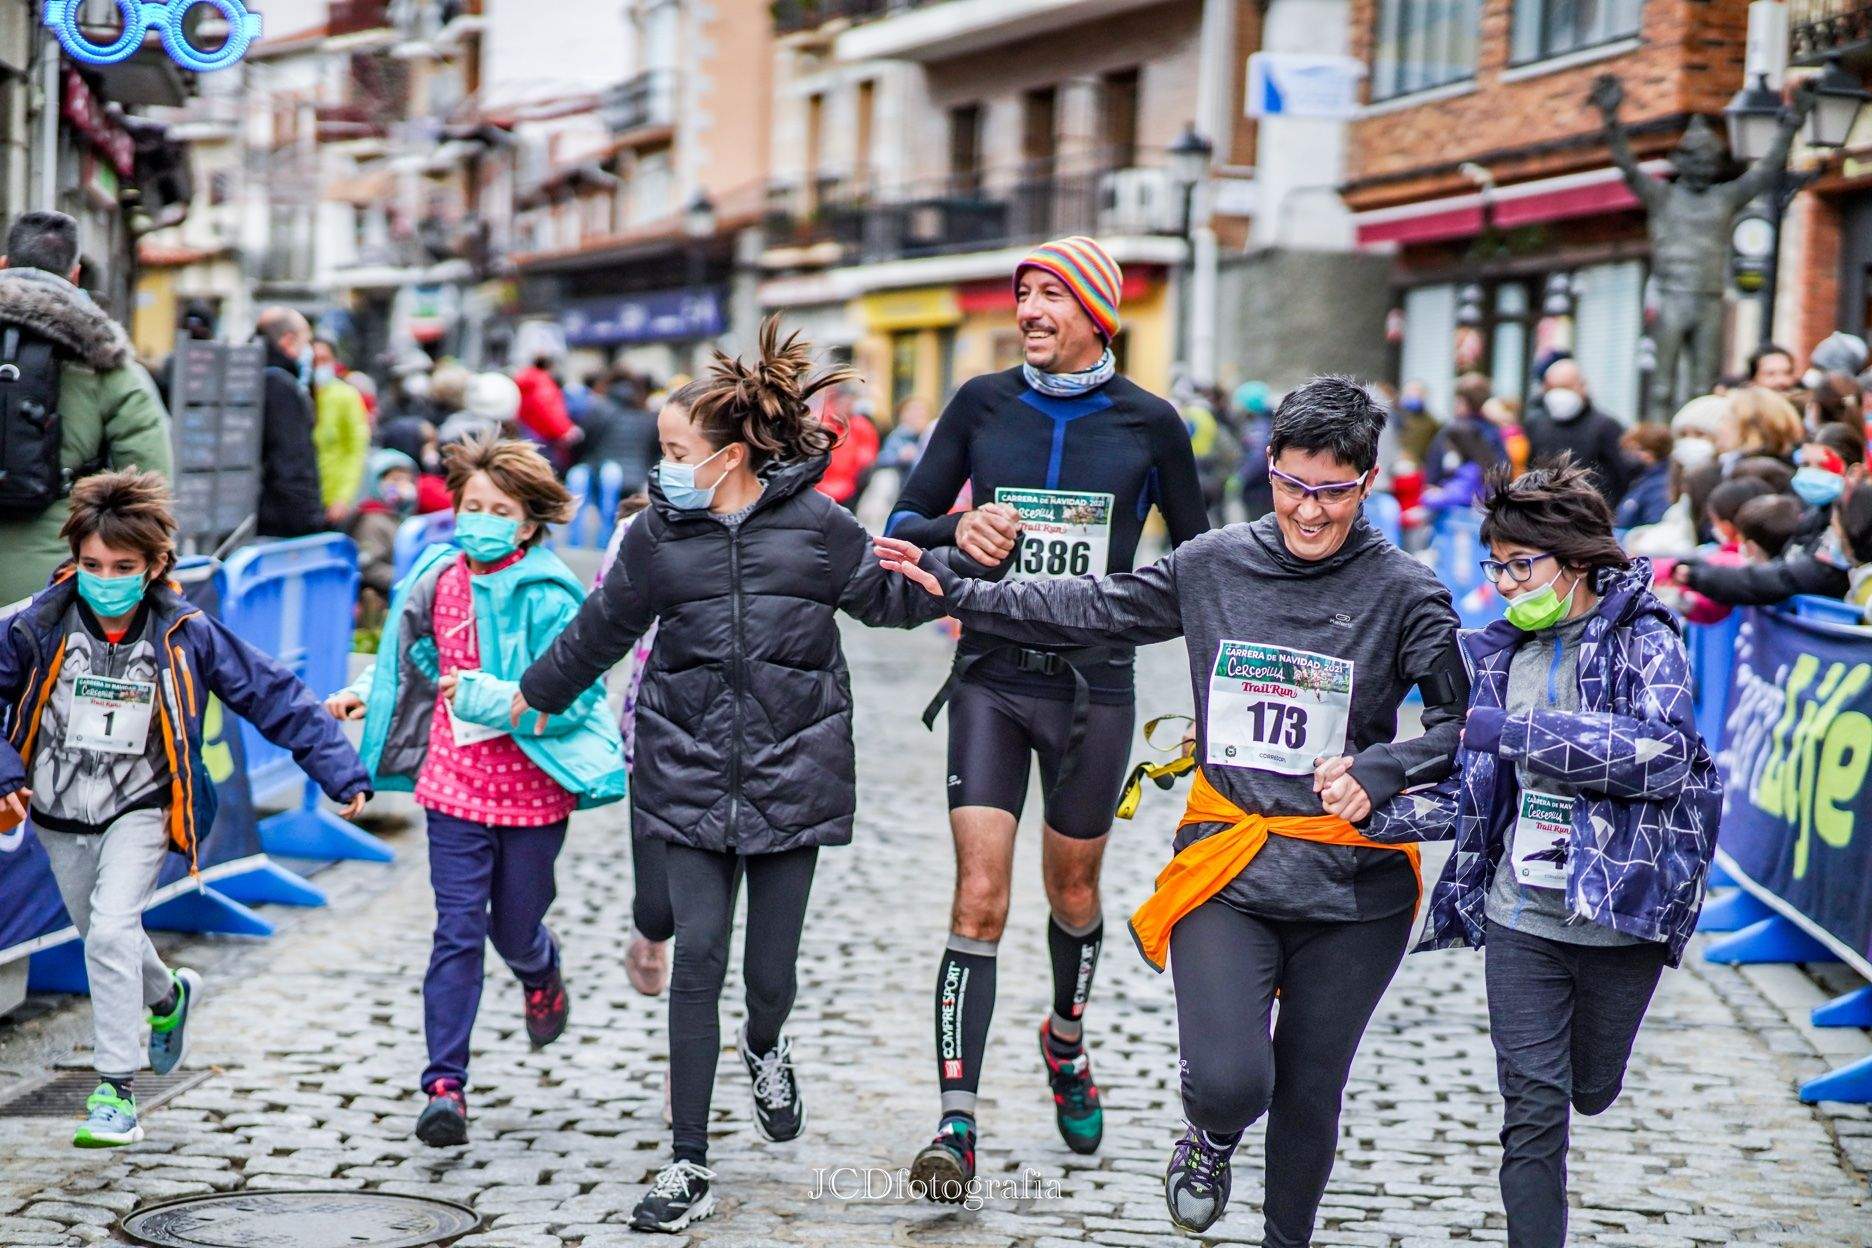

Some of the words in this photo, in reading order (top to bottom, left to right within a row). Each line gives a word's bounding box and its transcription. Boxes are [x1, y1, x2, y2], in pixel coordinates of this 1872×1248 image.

[1002, 494, 1038, 505] CARRERA
[1050, 497, 1087, 507] NAVIDAD
[1226, 647, 1265, 660] CARRERA
[1279, 654, 1321, 670] NAVIDAD
[1324, 664, 1343, 674] 2021
[1241, 681, 1270, 695] Trail
[1269, 684, 1298, 699] Run
[103, 711, 115, 737] 1
[1246, 700, 1308, 750] 173
[1560, 803, 1574, 811] NAV
[1535, 821, 1553, 832] Trail
